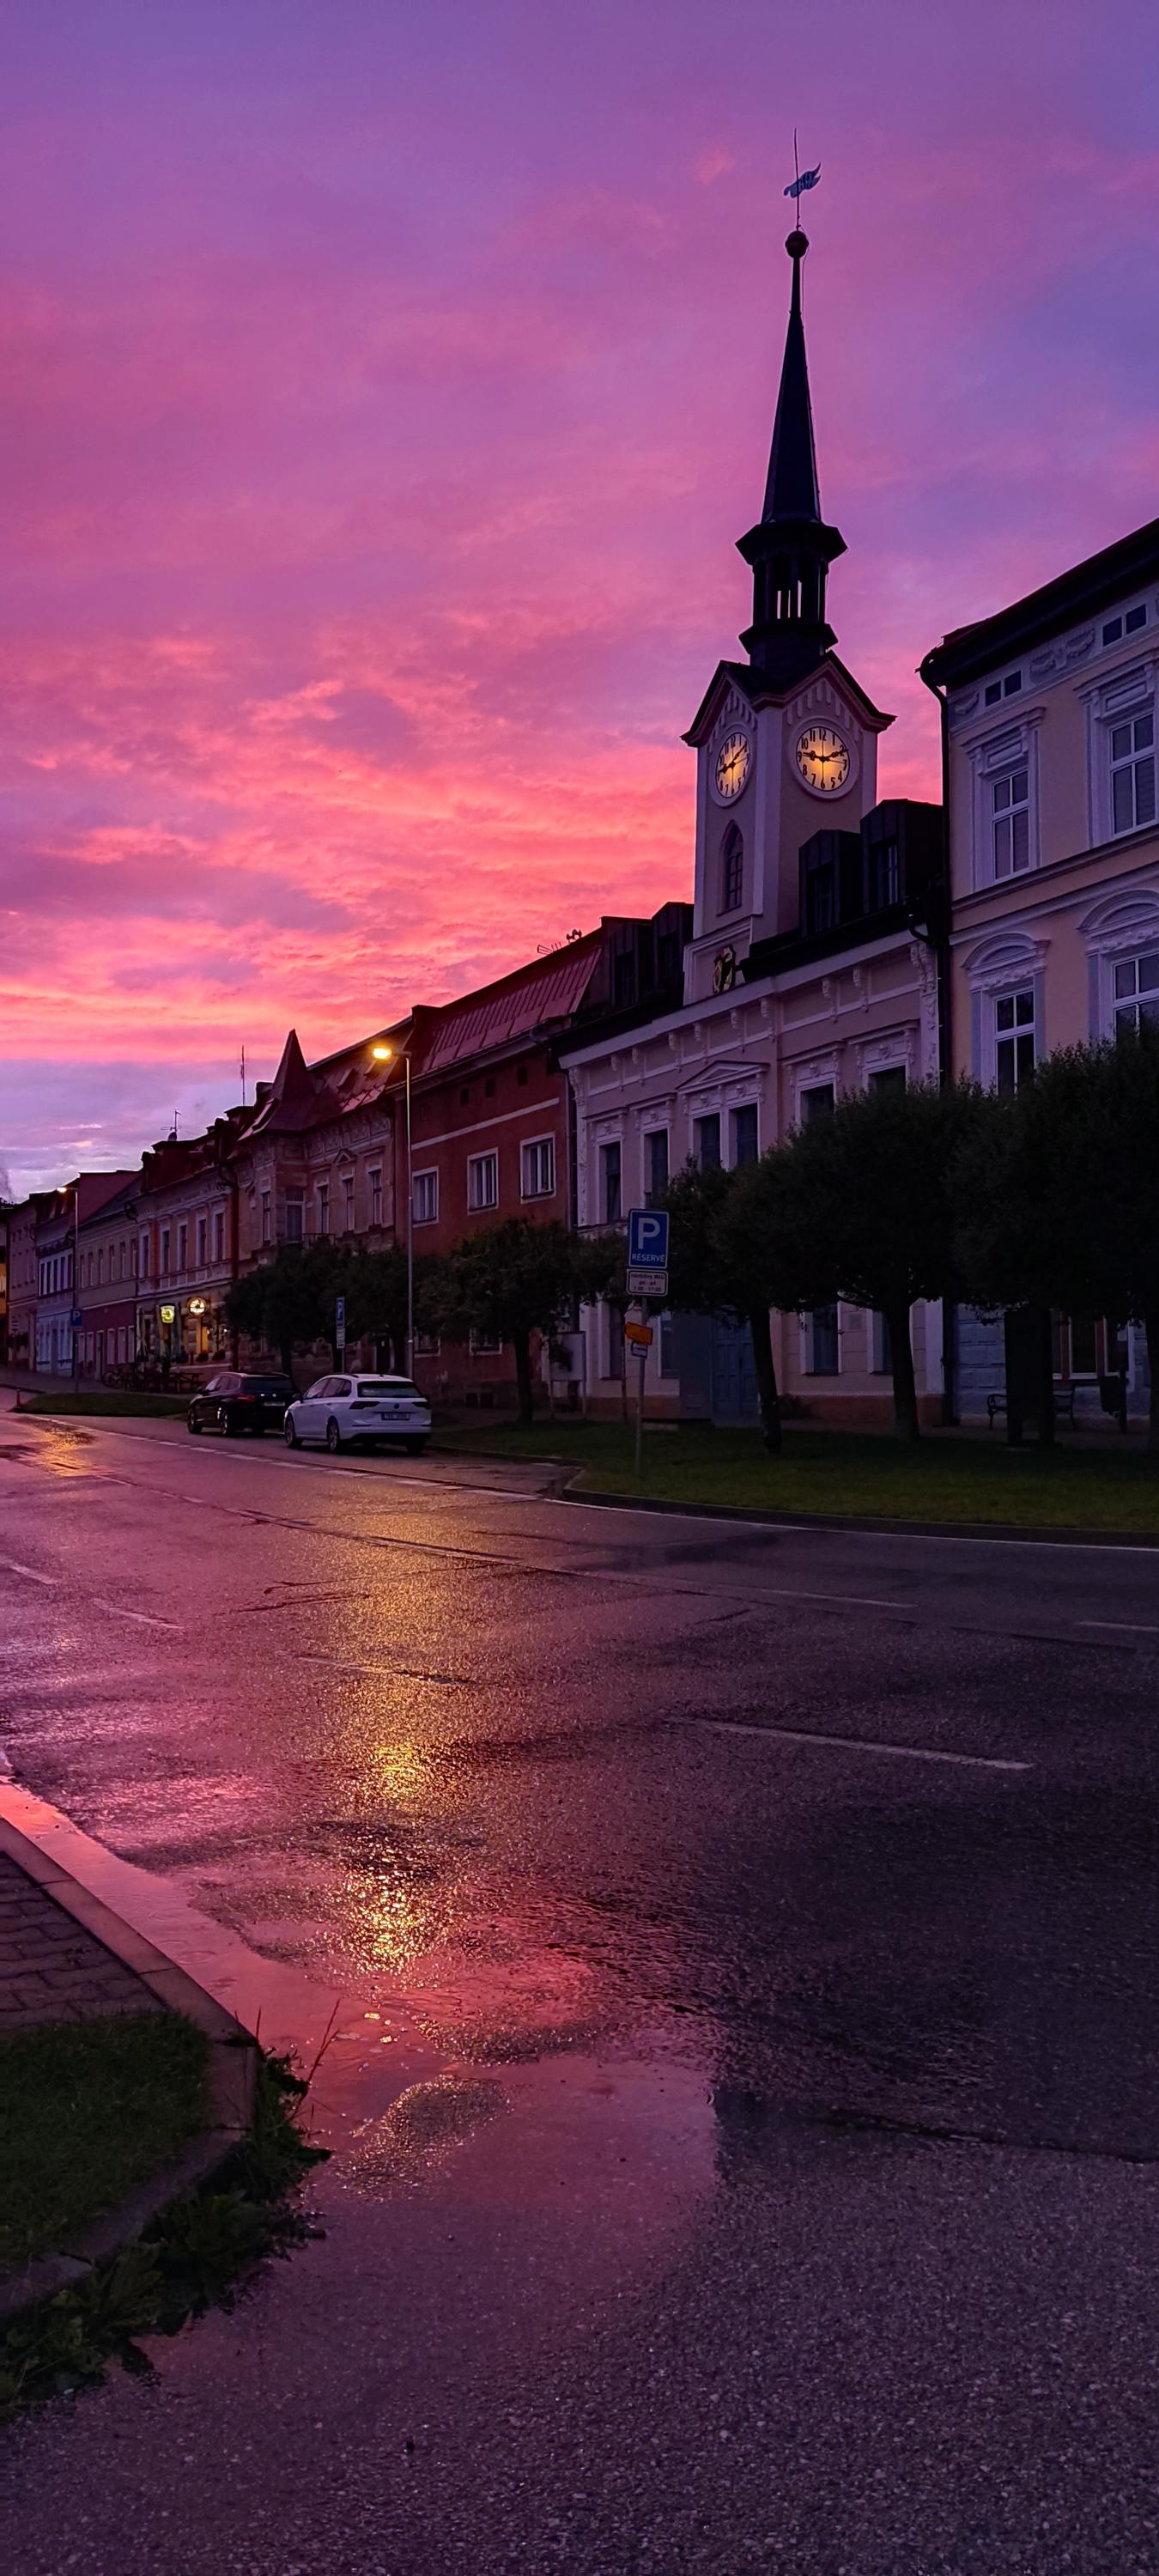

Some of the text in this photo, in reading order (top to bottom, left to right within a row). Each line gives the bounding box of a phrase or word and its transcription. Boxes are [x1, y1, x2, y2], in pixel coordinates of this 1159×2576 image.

[810, 729, 815, 742] 11
[819, 728, 827, 741] 12
[801, 738, 808, 750] 10
[839, 745, 845, 756] 2
[797, 751, 802, 762] 9
[803, 764, 807, 775] 8
[843, 759, 847, 770] 3
[811, 773, 816, 785] 7
[838, 771, 842, 782] 4
[820, 778, 825, 789] 6
[831, 777, 835, 789] 5
[638, 1217, 660, 1250] P
[338, 1301, 343, 1319] P
[72, 1311, 81, 1321] P
